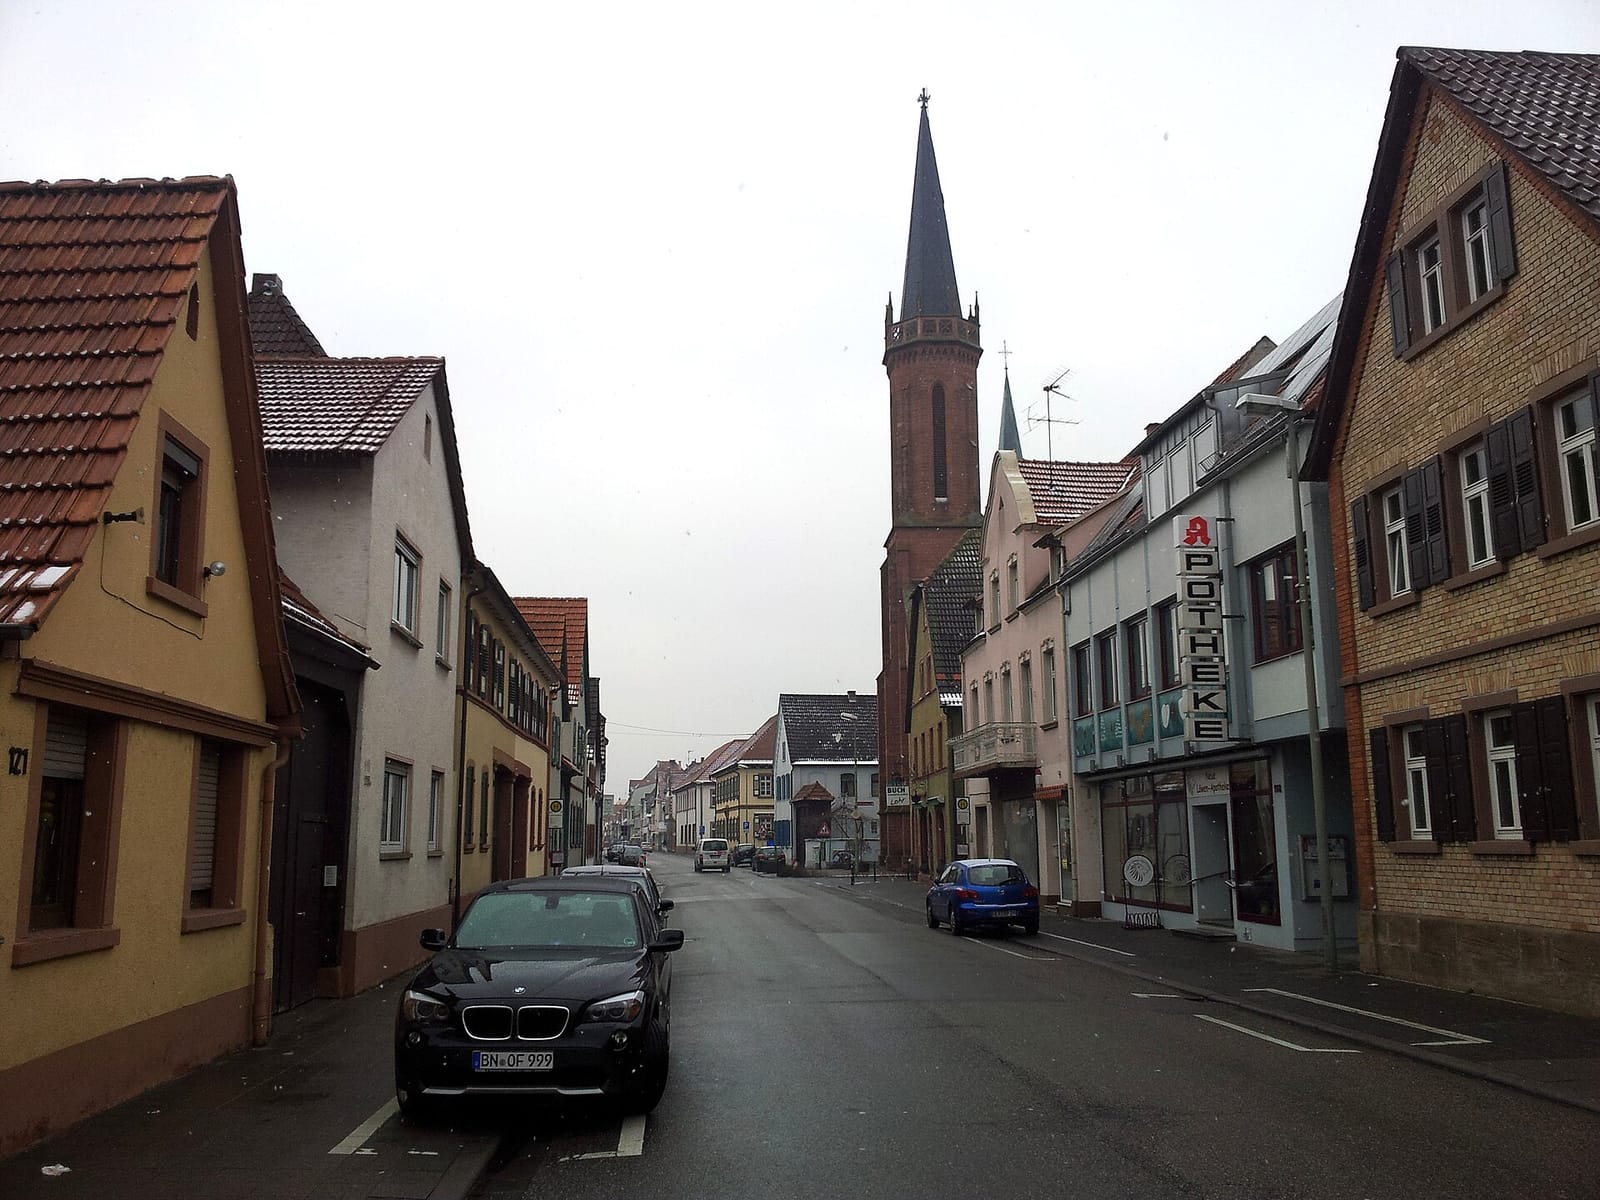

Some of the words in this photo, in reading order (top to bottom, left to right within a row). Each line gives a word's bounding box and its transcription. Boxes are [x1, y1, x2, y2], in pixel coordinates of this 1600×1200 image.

[1183, 516, 1223, 738] APOTHEKE
[8, 746, 29, 775] 121
[887, 786, 906, 794] BUCH
[481, 1053, 499, 1067] BN
[507, 1053, 525, 1067] OF
[527, 1053, 553, 1067] 999
